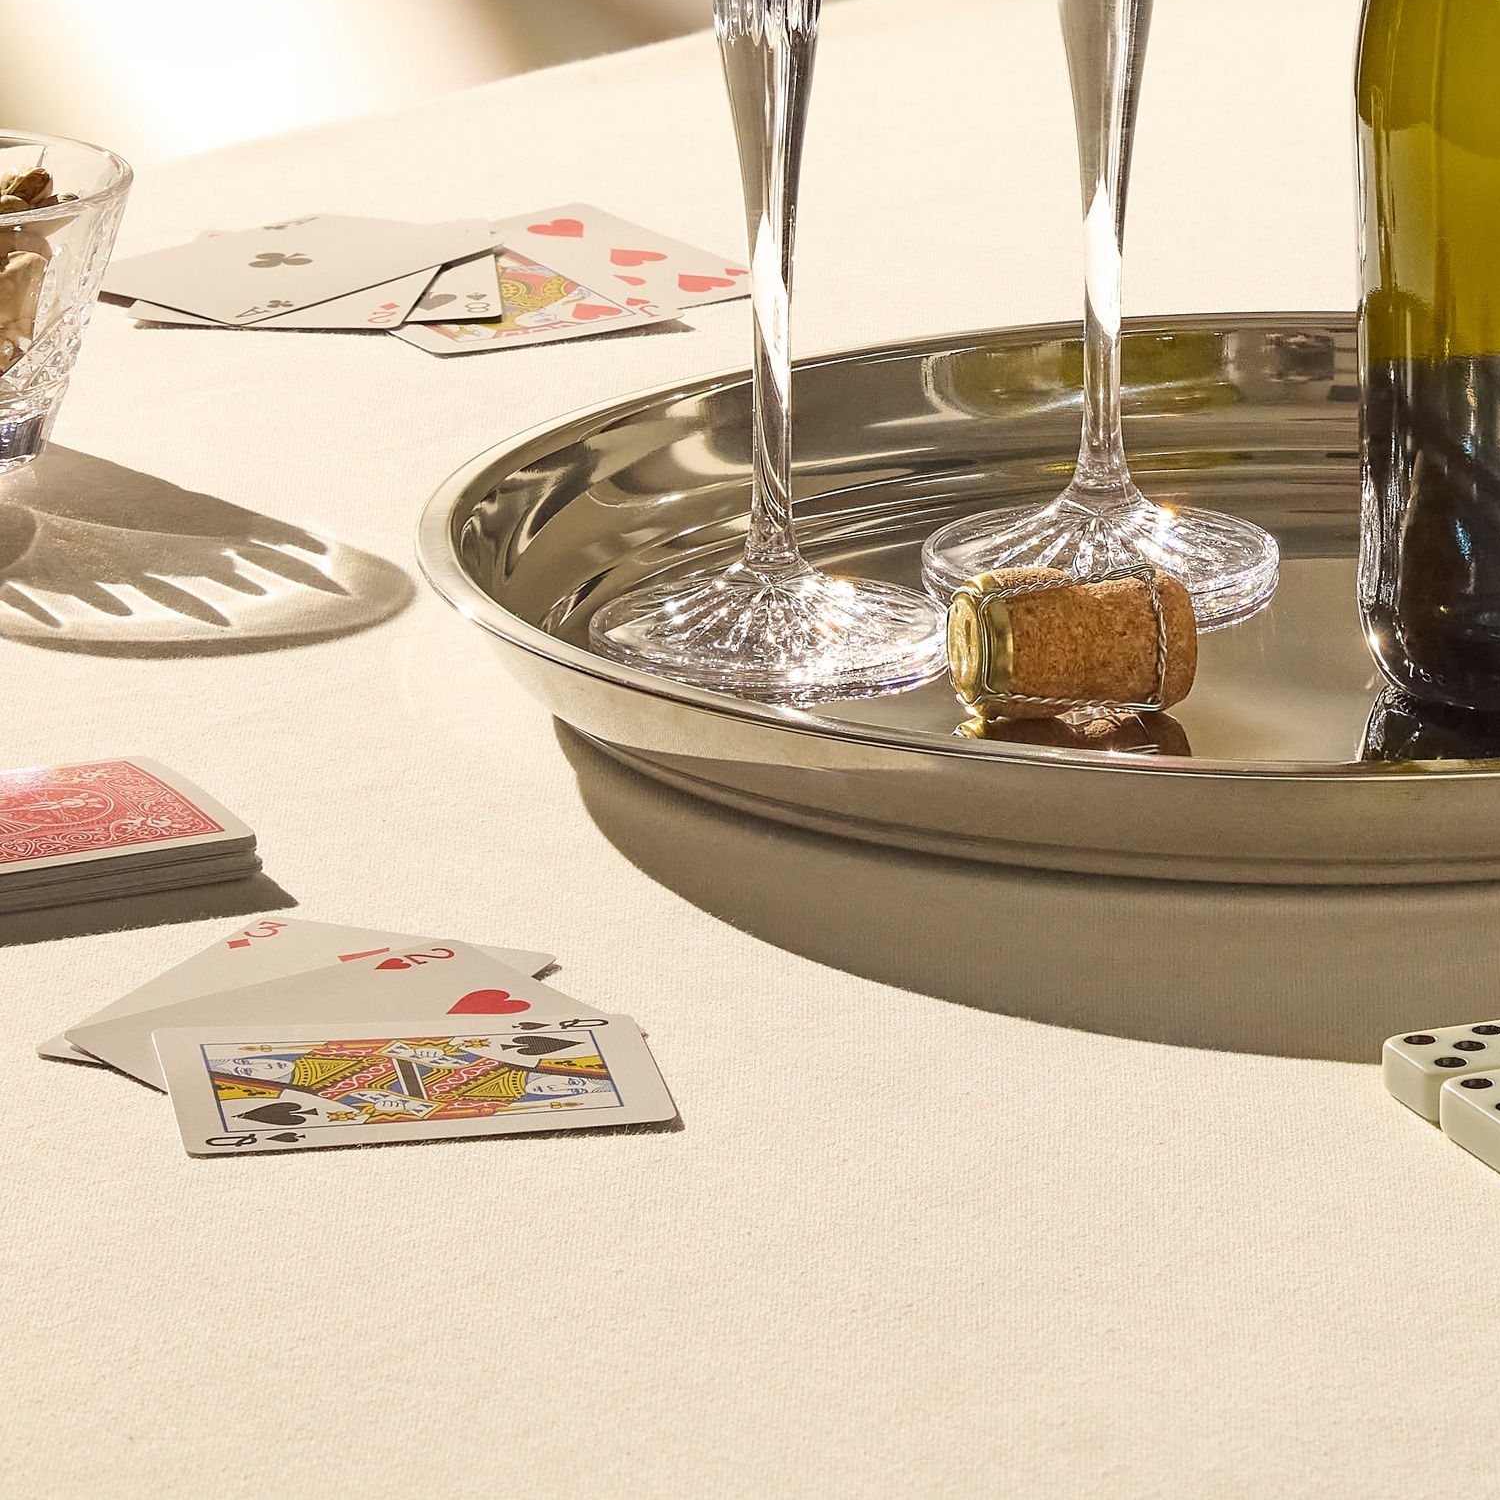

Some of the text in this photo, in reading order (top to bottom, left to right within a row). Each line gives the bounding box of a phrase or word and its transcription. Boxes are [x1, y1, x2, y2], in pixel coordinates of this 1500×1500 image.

[235, 306, 271, 318] A
[465, 302, 490, 313] 8
[636, 304, 660, 318] J
[367, 311, 397, 323] 2
[243, 920, 288, 938] 3
[403, 947, 455, 965] 2
[558, 1018, 609, 1030] Q
[205, 1133, 258, 1147] Q
